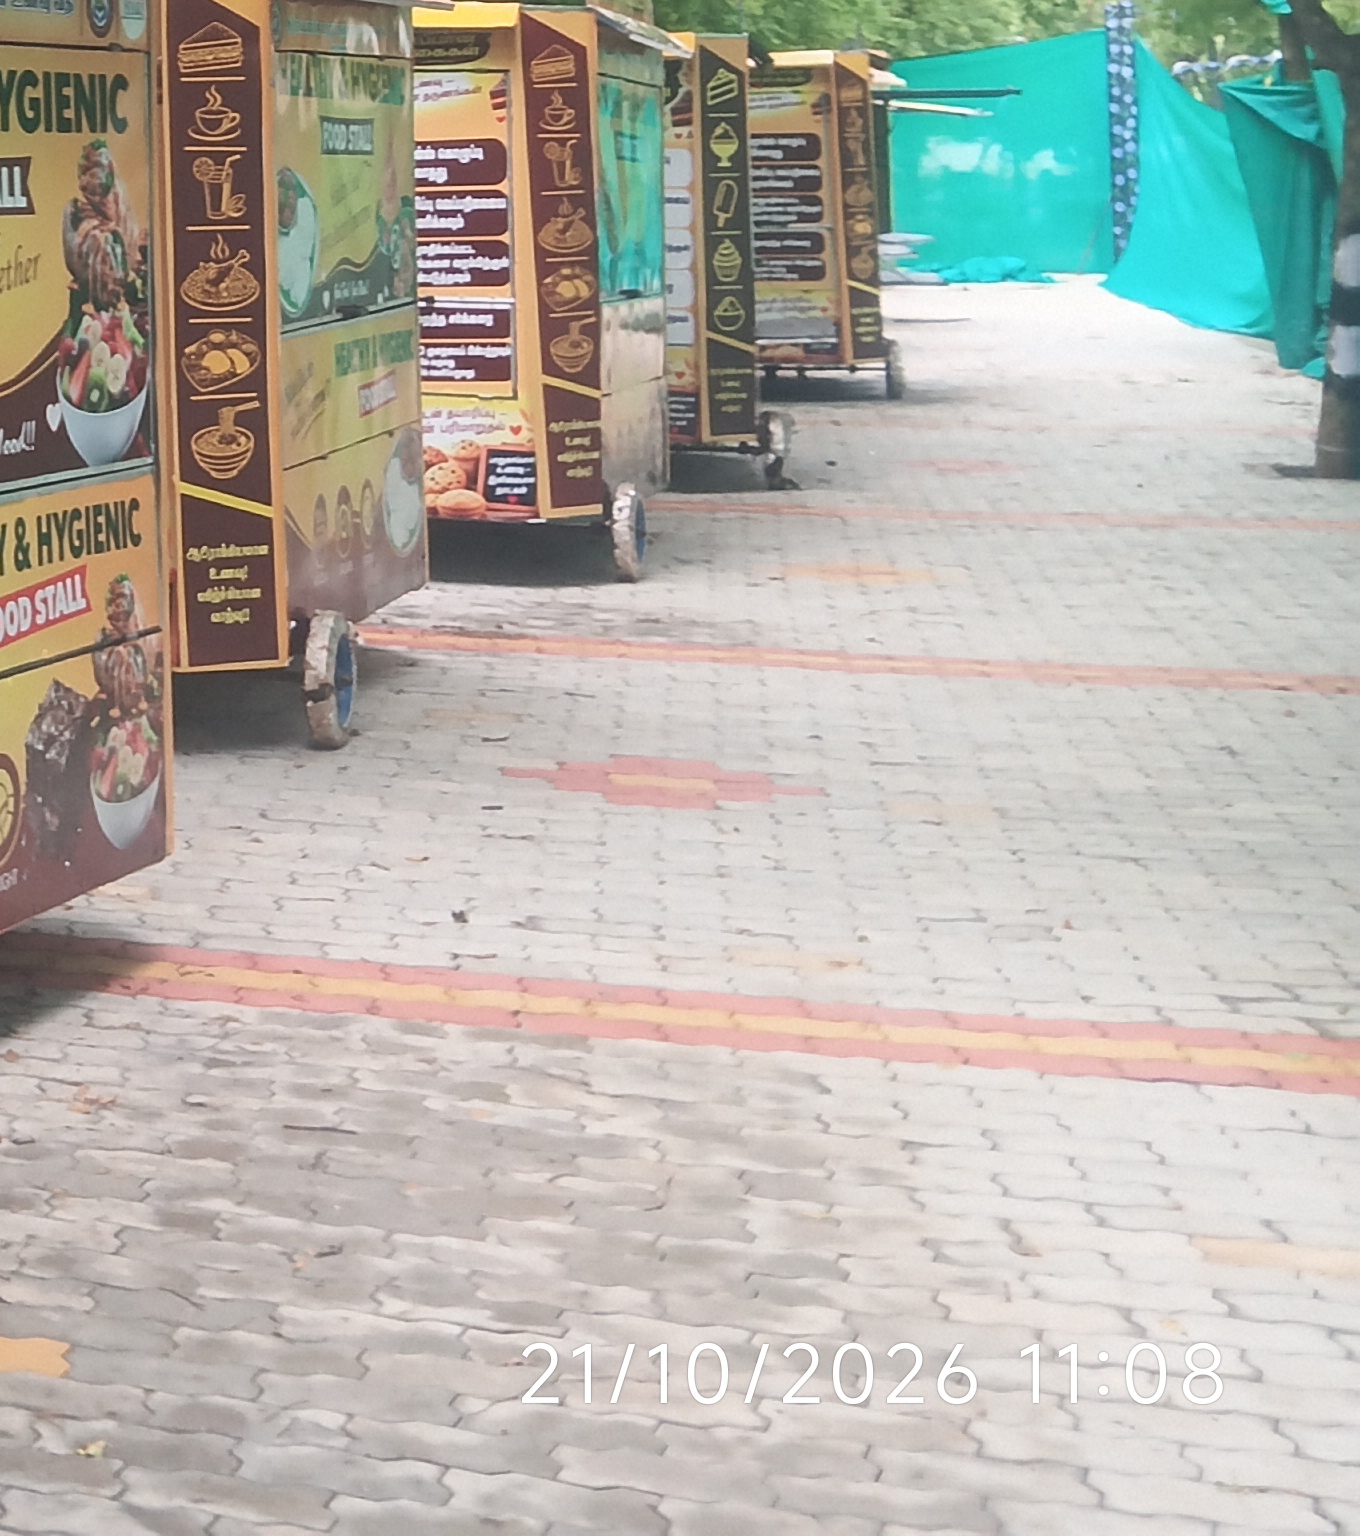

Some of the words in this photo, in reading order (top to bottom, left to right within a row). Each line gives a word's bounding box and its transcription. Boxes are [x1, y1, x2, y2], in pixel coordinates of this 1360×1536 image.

[14, 516, 31, 572] &
[35, 498, 142, 566] HYGIENIC
[34, 572, 87, 624] STALL
